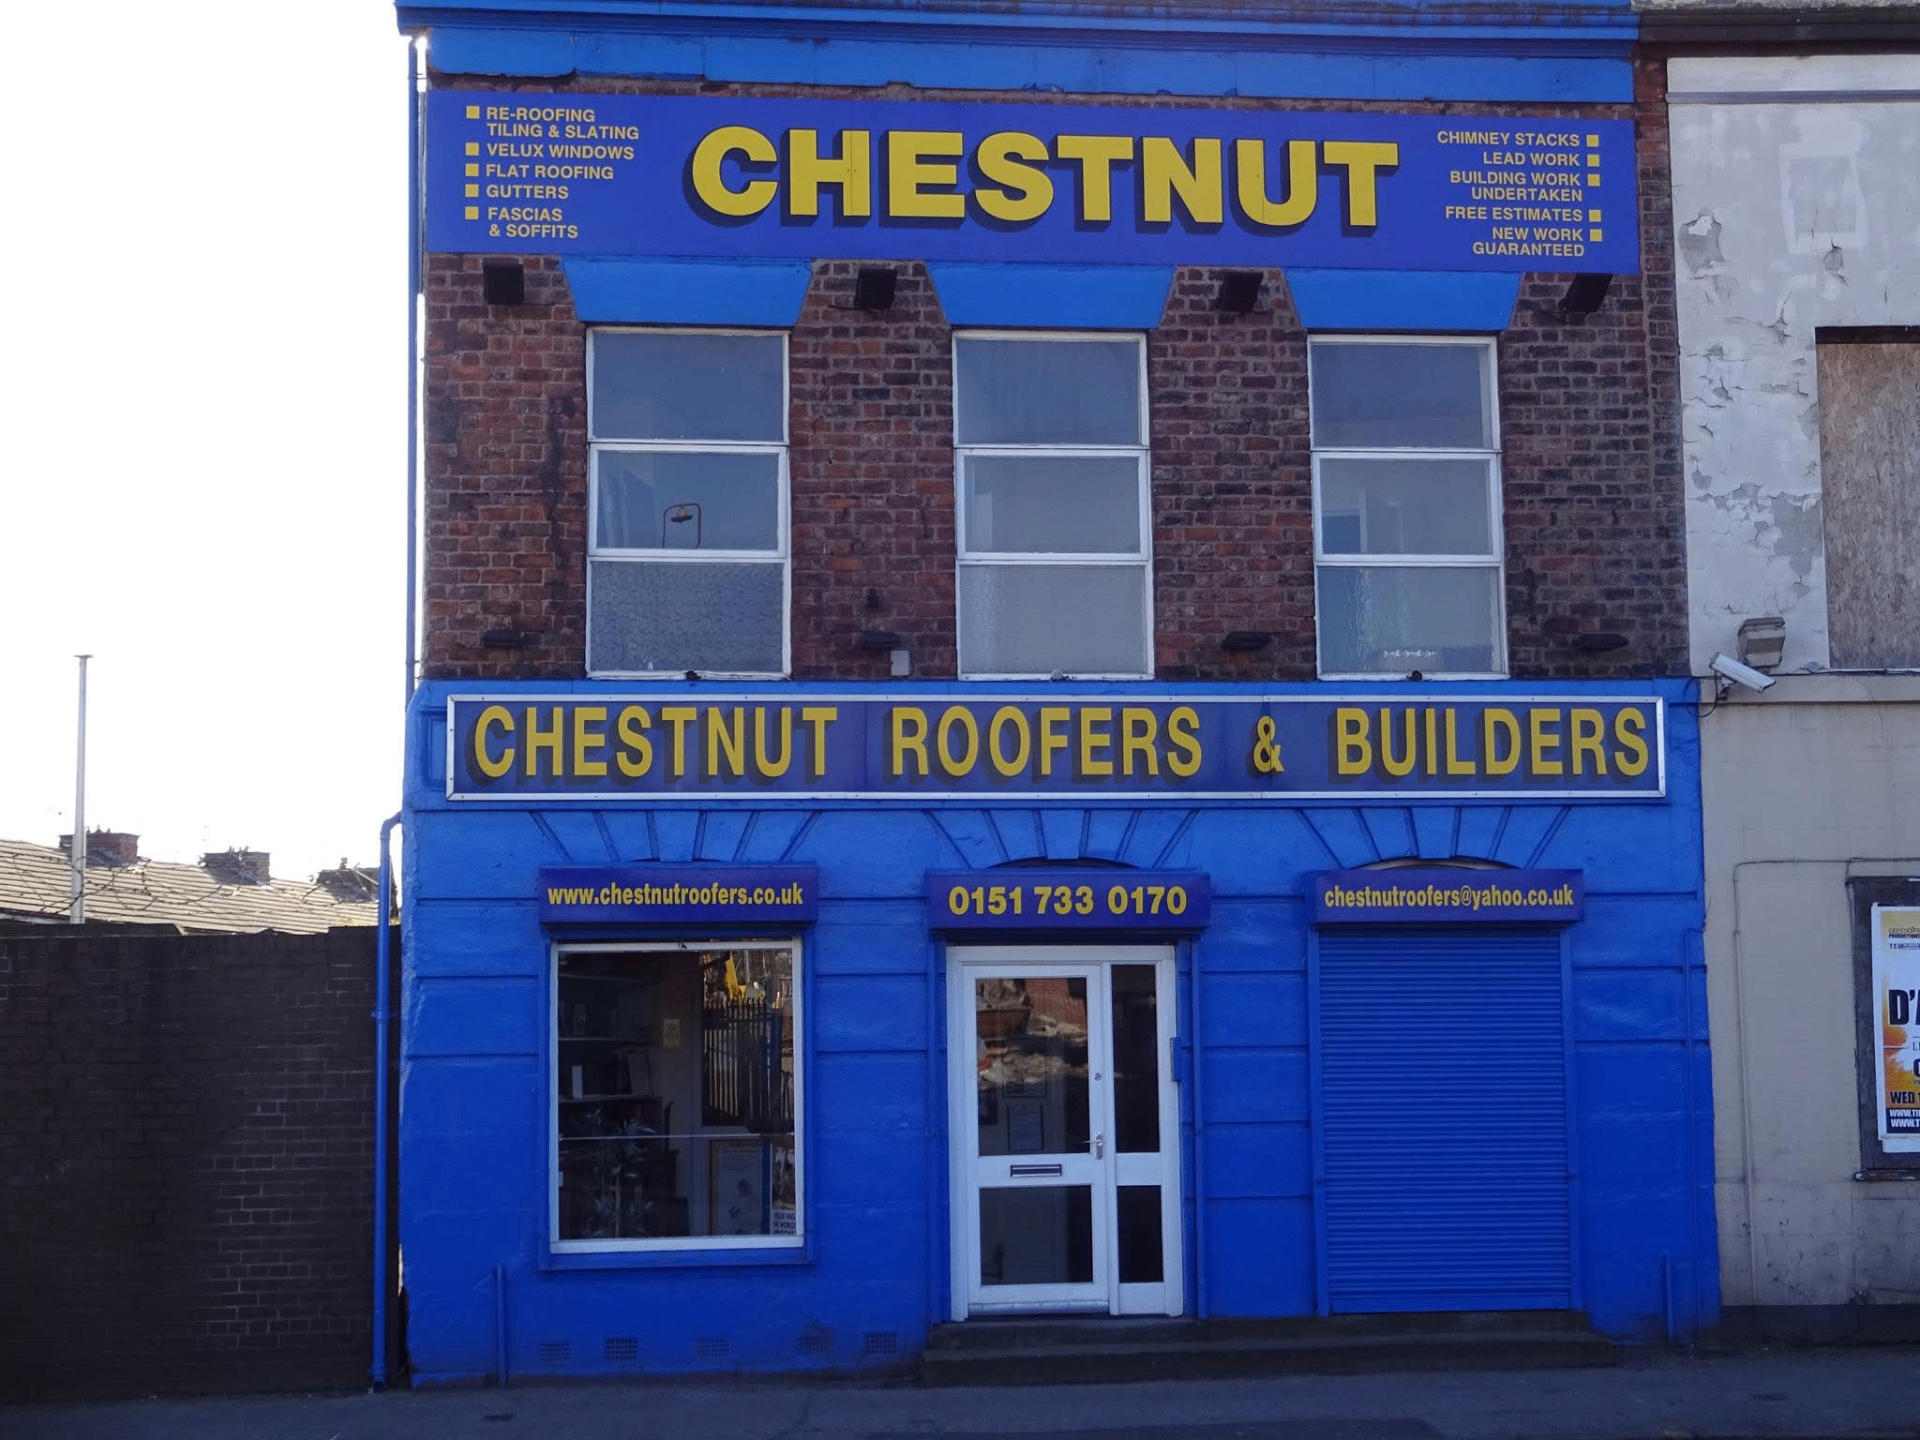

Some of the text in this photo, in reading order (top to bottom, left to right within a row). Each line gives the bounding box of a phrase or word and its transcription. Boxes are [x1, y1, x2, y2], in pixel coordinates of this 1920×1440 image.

[486, 106, 595, 123] RE-ROOFING
[486, 122, 639, 140] TILING & SLATING
[1437, 130, 1580, 147] CHIMNEY STACKS
[486, 143, 635, 160] VELUX WINDOWS
[1483, 151, 1580, 167] LEAD WORK
[486, 163, 614, 180] FLAT ROOFING
[692, 125, 1399, 226] CHESTNUT
[1450, 170, 1581, 186] BUILDING WORK
[486, 184, 569, 200] GUTTERS
[1471, 186, 1583, 202] UNDERTAKEN
[487, 206, 563, 222] FASCIAS
[1445, 205, 1583, 222] FREE ESTIMATES
[489, 223, 579, 239] & SOFFITS
[1492, 226, 1583, 242] NEW WORK
[1472, 241, 1585, 257] GUARANTEED
[474, 704, 1649, 778] CHESTNUT ROOFERS & BUILDERS
[547, 881, 803, 905] www.chestnutroofers.co.uk
[948, 885, 1187, 916] 0151 733 0170
[1324, 884, 1574, 911] chestnutroofers@yahoo.co.uk
[1889, 1091, 1916, 1104] WED
